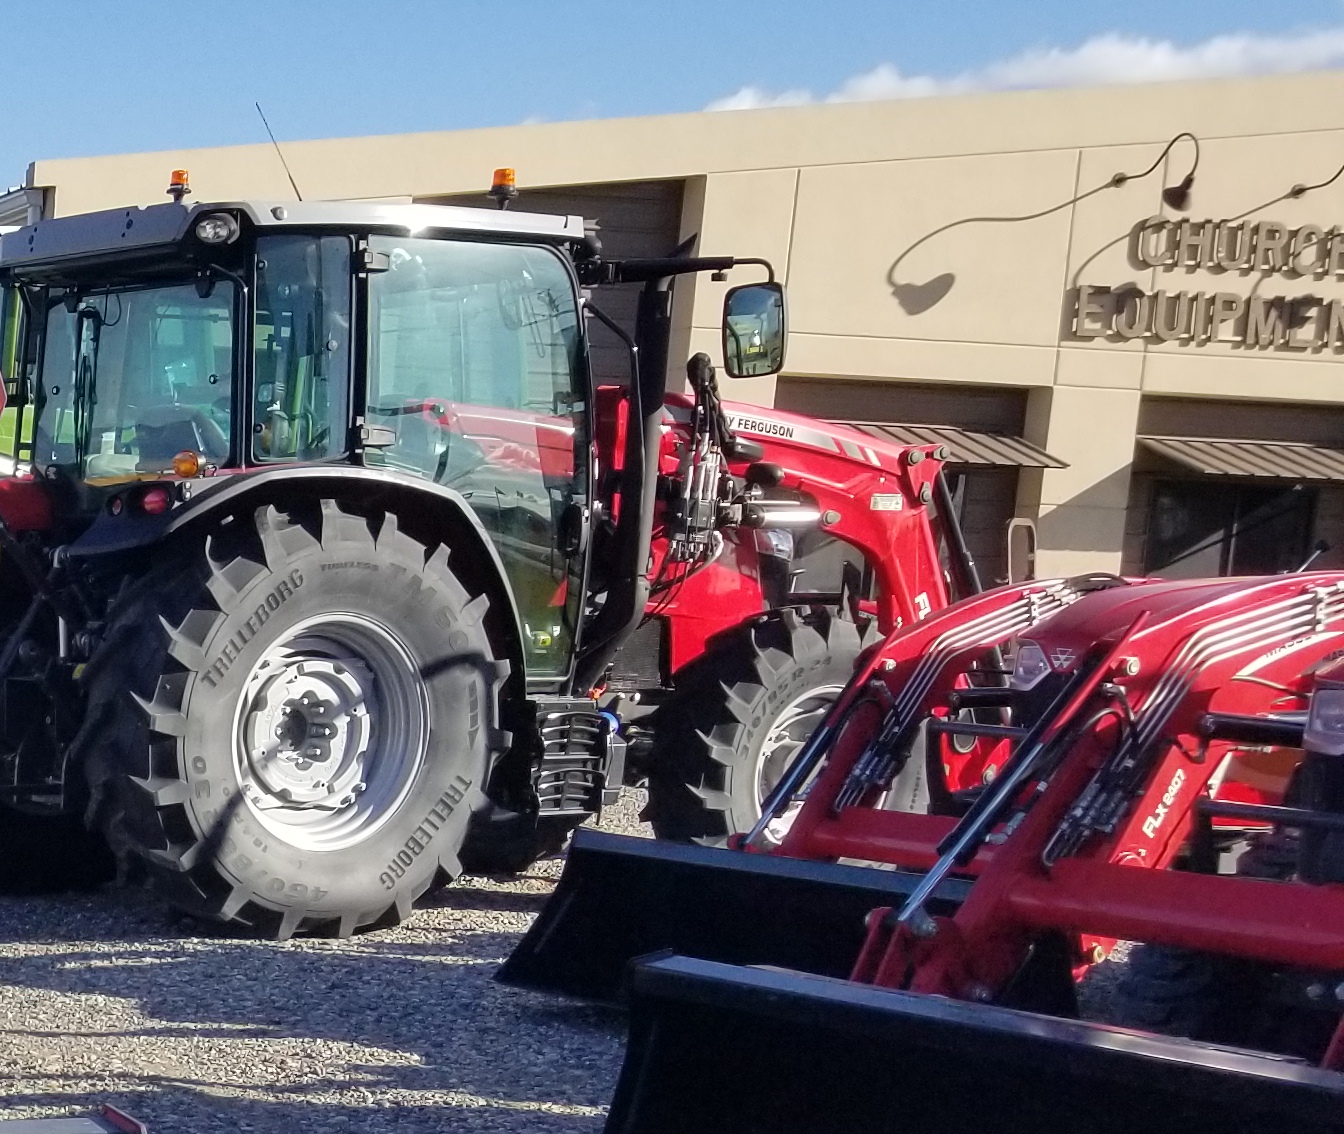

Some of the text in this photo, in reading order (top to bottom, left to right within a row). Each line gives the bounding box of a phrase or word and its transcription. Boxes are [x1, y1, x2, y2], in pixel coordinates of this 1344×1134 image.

[737, 418, 794, 438] FERGUSON
[201, 568, 304, 688] TRELLEBORG
[379, 775, 472, 890] TRELLEBORG
[1141, 768, 1187, 839] FLX 2407
